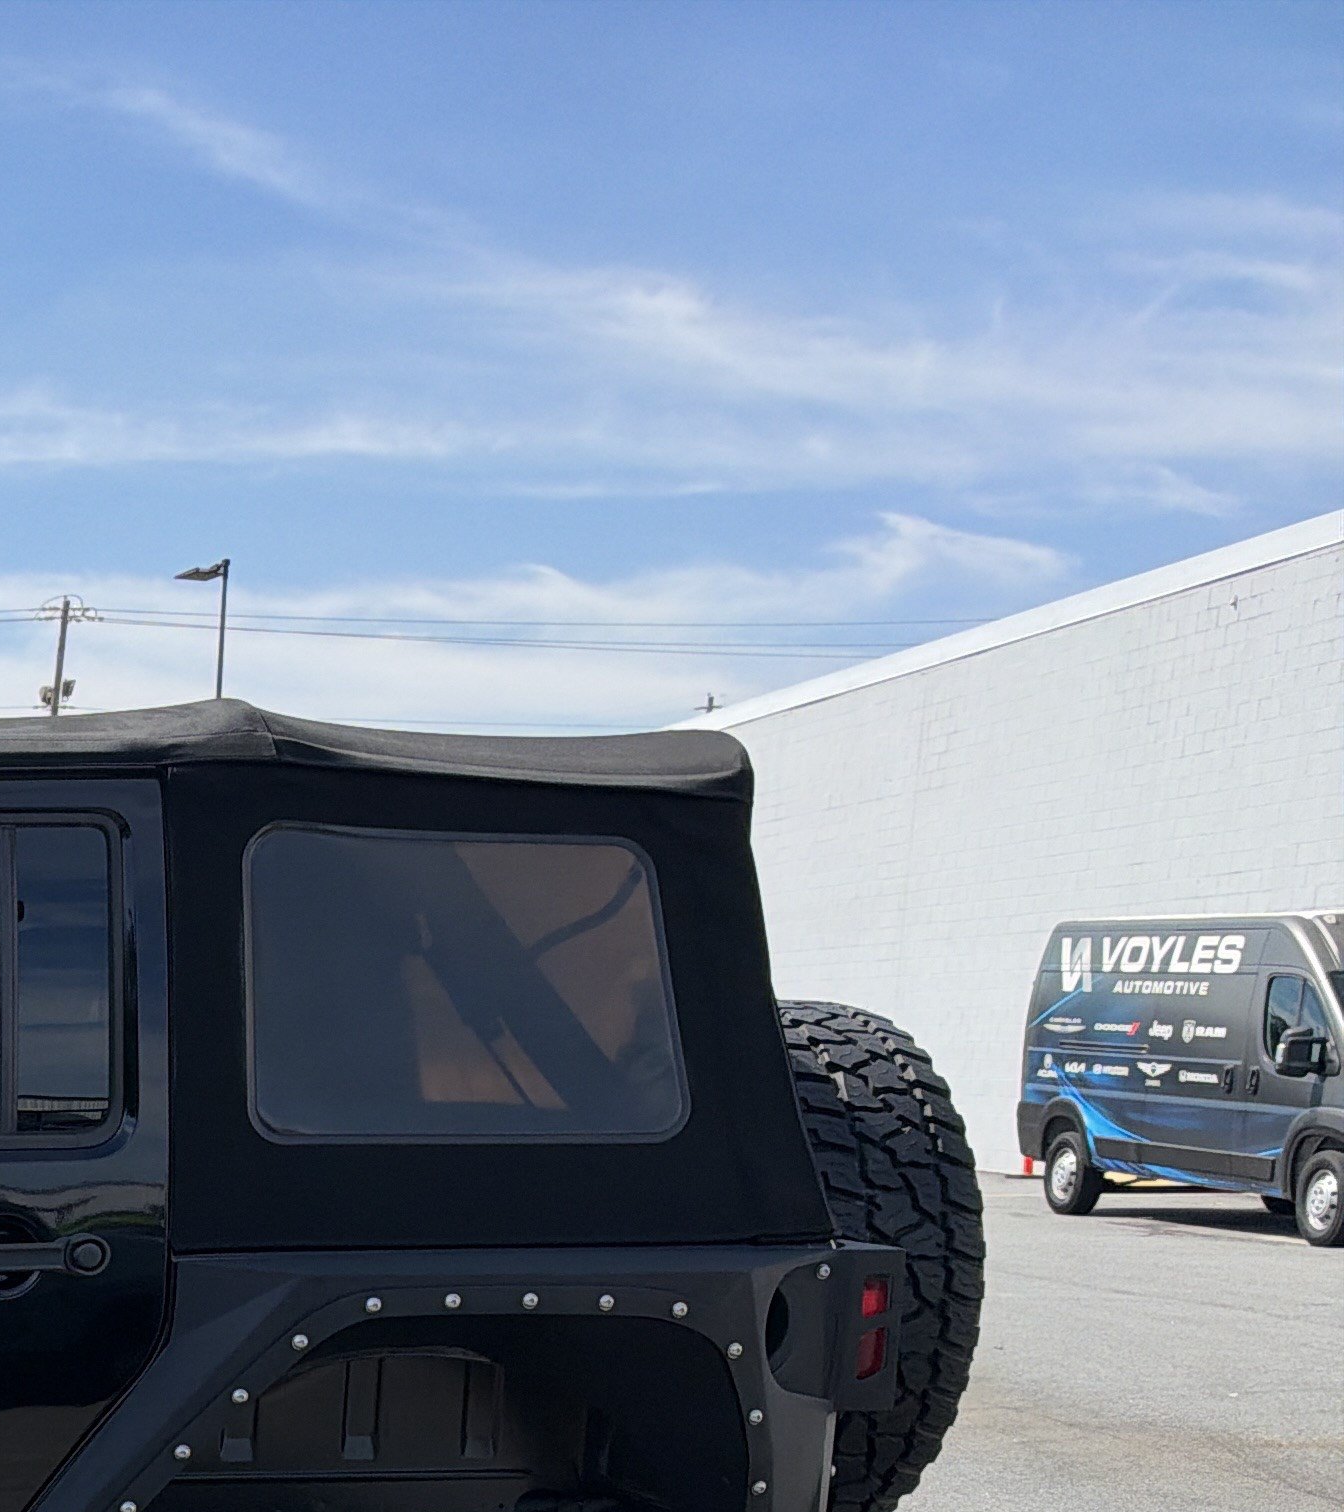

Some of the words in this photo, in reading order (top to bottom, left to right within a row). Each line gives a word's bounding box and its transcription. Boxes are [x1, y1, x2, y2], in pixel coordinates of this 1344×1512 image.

[1101, 935, 1246, 974] VOYLES
[1112, 979, 1210, 995] AUTOMOTIVE
[1195, 1026, 1227, 1038] RAM
